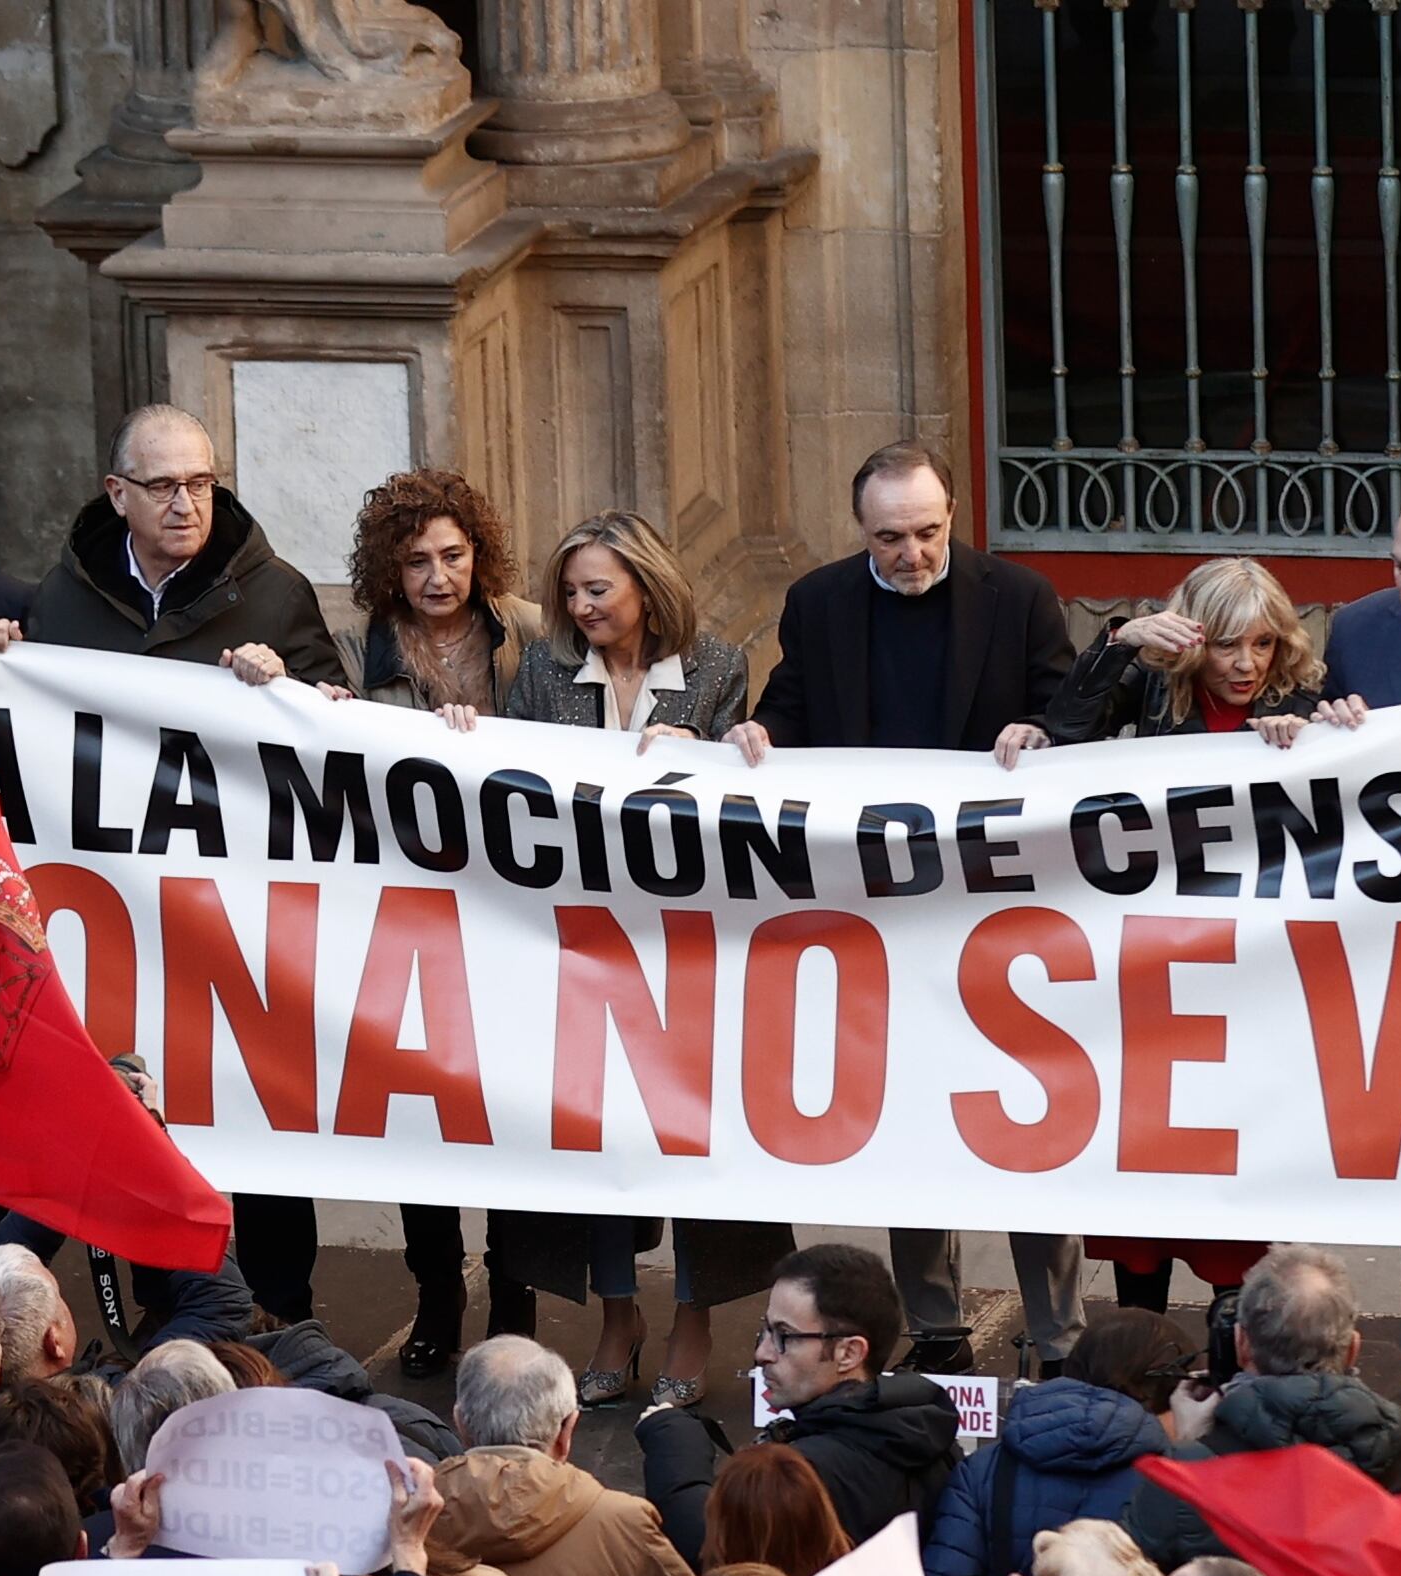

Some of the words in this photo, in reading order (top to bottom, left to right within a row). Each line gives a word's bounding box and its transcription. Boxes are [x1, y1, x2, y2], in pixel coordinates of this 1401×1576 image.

[72, 711, 229, 858] LA
[258, 770, 817, 899] MOCIÓN
[856, 798, 1036, 899] DE
[551, 905, 889, 1166] NO
[949, 905, 1239, 1176] SE
[100, 1275, 121, 1328] SONY
[948, 1385, 985, 1408] ONA
